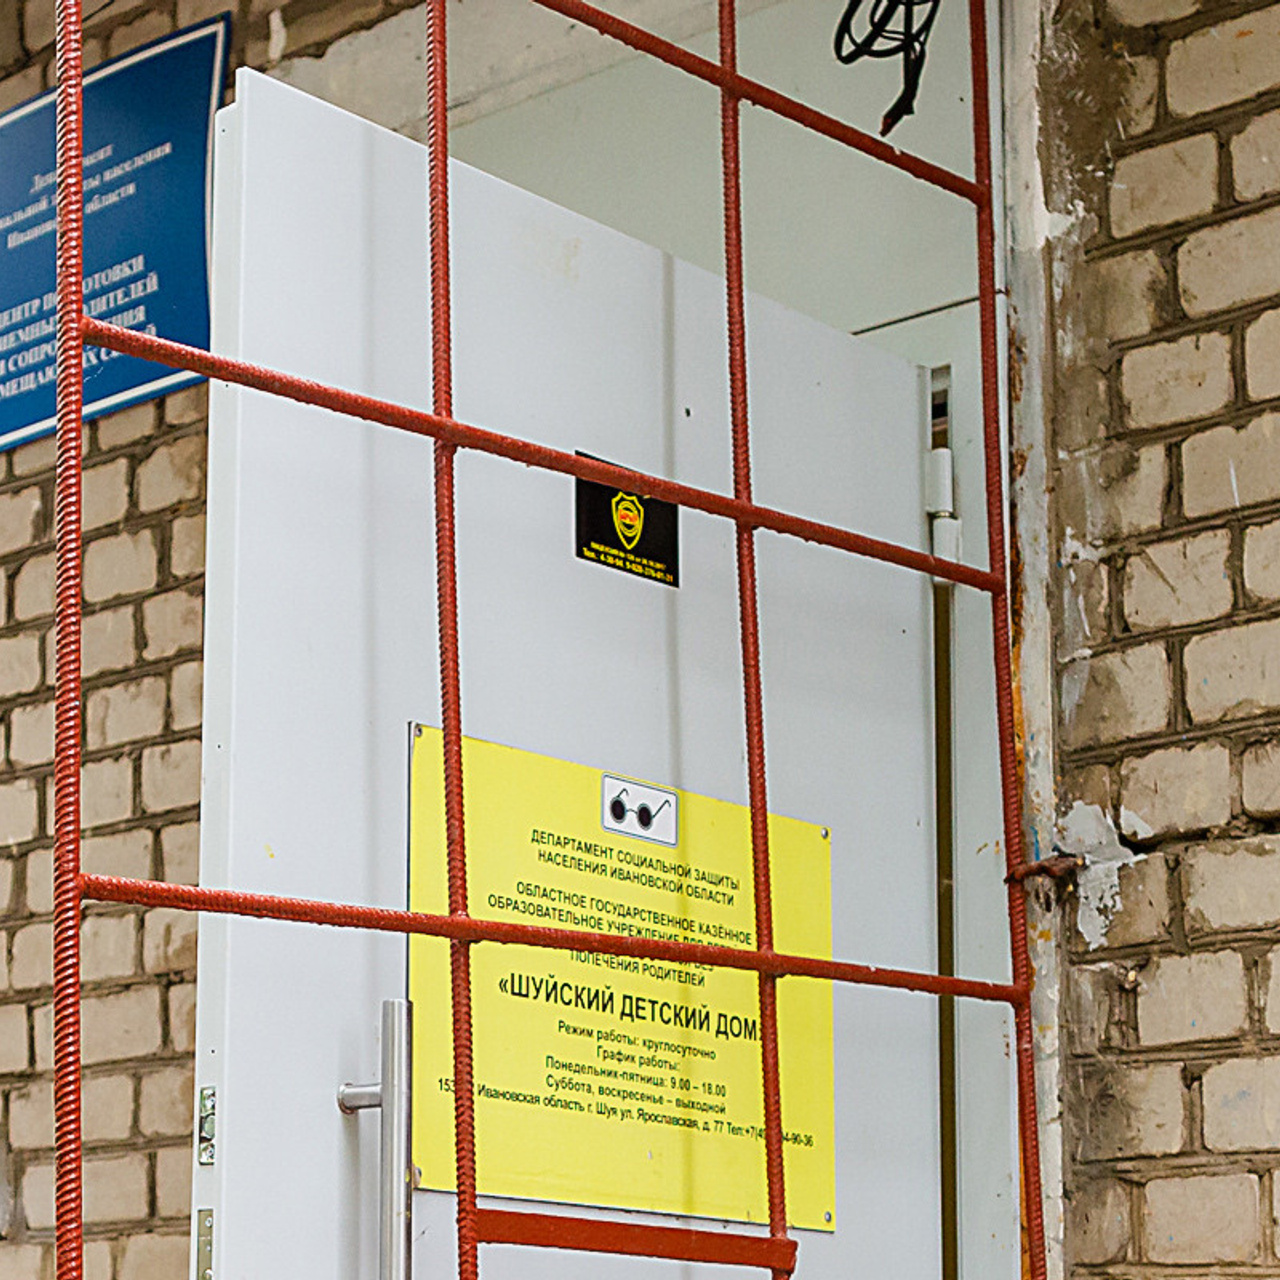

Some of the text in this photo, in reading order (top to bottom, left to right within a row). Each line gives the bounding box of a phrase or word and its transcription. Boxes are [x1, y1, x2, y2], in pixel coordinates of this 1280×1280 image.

[531, 829, 740, 891] ДЕПАРТАМЕНТ СОЦИАЛЬНОЙ ЗАЩИТЫ
[538, 850, 734, 906] НАСЕЛЕНИЯ ИВАНОВСКОЙ ОБЛАСТИ
[488, 894, 603, 930] ОБРАЗОВАТЕЛЬНОЕ
[516, 881, 587, 908] ОБЛАСТНОЕ
[590, 898, 696, 933] ГОСУДАРСТВЕННОЕ
[698, 923, 752, 945] КАЗЁННОЕ
[570, 950, 640, 974] ПОПЕЧЕНИЯ
[642, 963, 705, 987] РОДИТЕЛЕЙ
[499, 973, 761, 1041] «ШУЙСКИЙ ДЕТСКИЙ ДОМ
[558, 1020, 717, 1060] Режим работы: круглосуточно
[596, 1045, 680, 1071] График работы:
[546, 1055, 668, 1088] Понедельник-пятница:
[670, 1076, 691, 1092] 9.00
[702, 1082, 726, 1097] 18.00
[546, 1074, 595, 1096] Суббота,
[599, 1086, 664, 1105] воскресенье
[676, 1097, 726, 1115] выходной
[477, 1083, 540, 1105] Ивановская
[543, 1095, 585, 1112] область
[596, 1101, 618, 1119] Шуя
[620, 1108, 633, 1121] ул.
[637, 1107, 700, 1130] Ярославская,
[713, 1120, 724, 1132] 77
